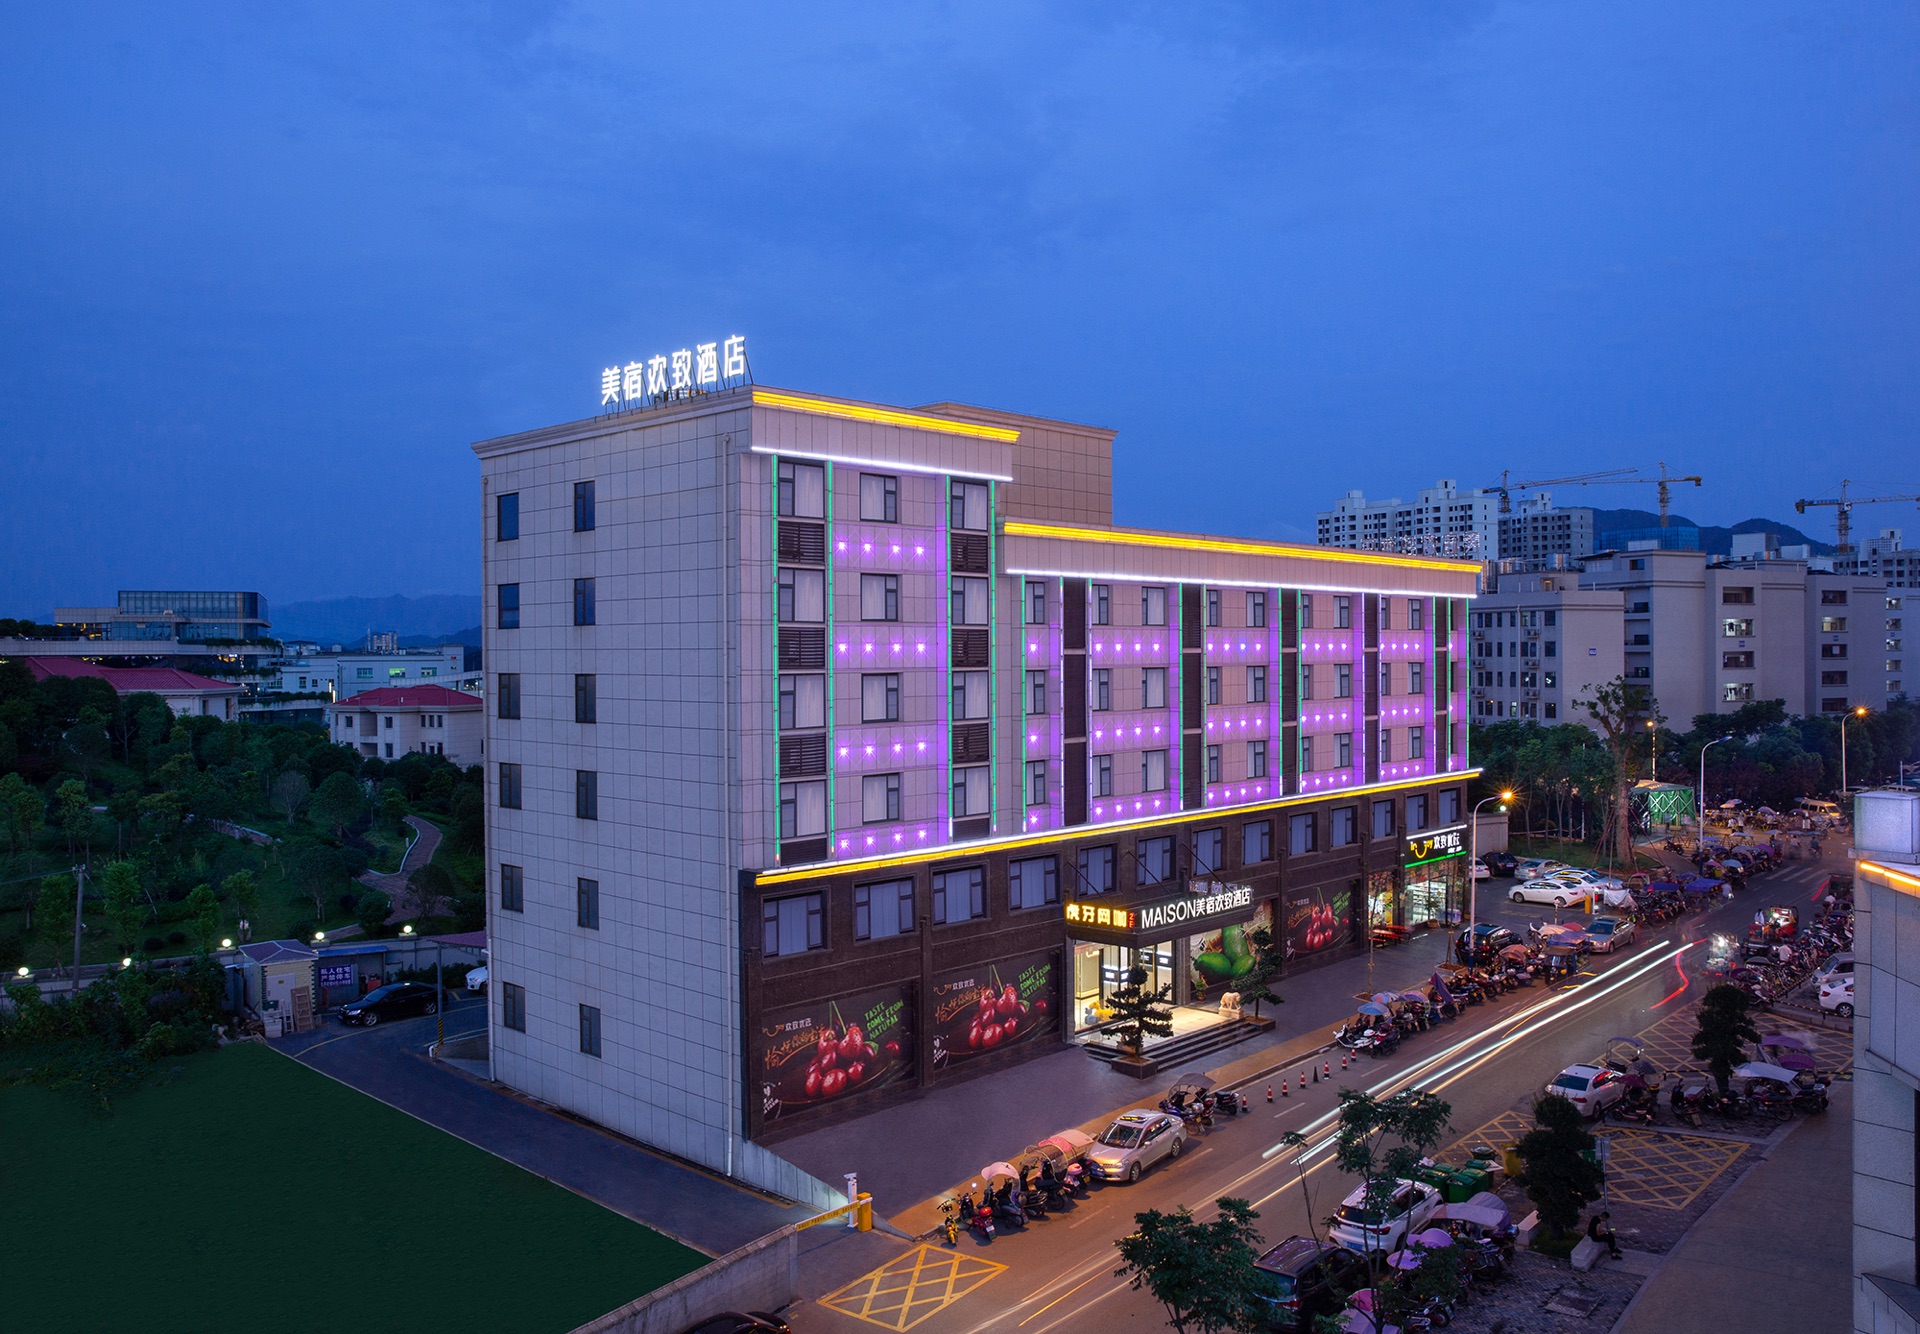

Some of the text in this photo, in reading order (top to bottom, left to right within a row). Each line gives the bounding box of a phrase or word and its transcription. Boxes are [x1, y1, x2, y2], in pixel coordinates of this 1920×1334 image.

[602, 334, 746, 406] 美宿欢致酒店
[1141, 899, 1196, 929] MAISON
[1196, 887, 1250, 917] 美宿欢致酒店
[864, 1001, 886, 1021] TASTE
